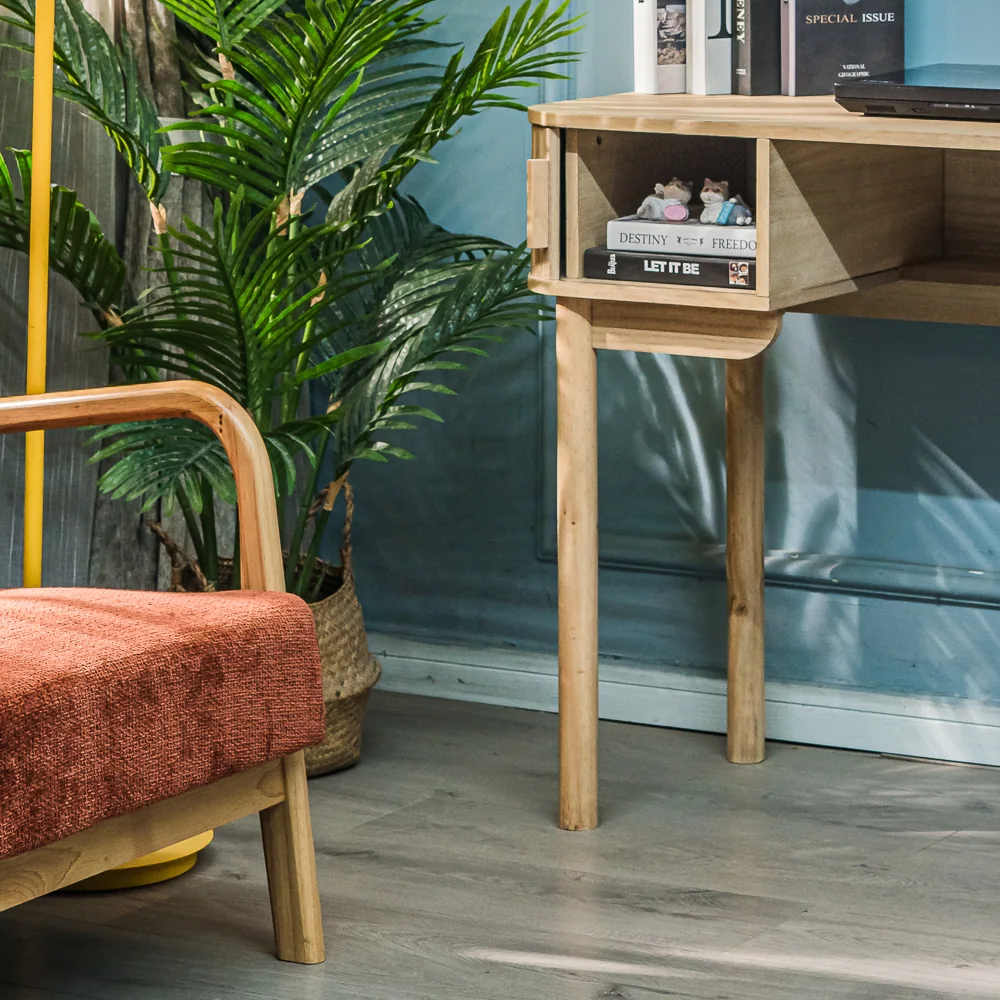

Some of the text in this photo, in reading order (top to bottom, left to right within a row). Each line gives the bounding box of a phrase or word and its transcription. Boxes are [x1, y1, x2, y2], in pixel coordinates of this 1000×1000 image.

[805, 12, 896, 24] SPECIAL ISSUE
[619, 232, 668, 246] DESTINY
[643, 259, 700, 275] LET IT BE
